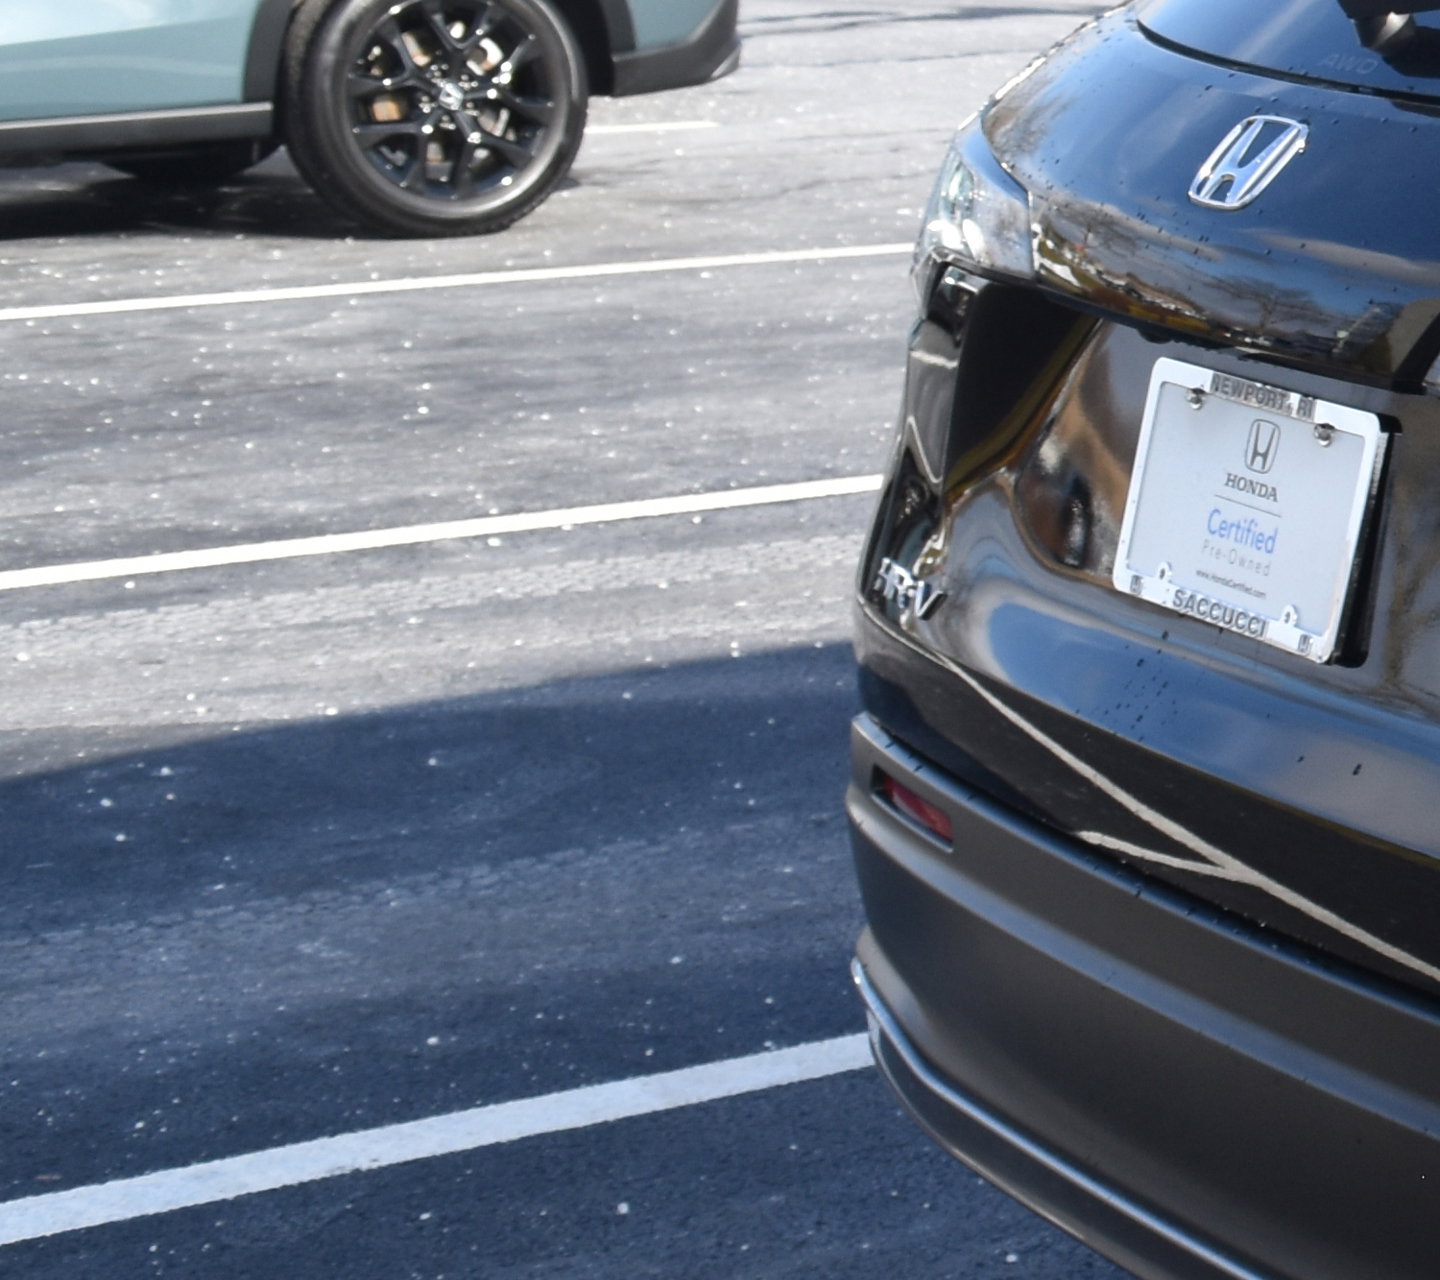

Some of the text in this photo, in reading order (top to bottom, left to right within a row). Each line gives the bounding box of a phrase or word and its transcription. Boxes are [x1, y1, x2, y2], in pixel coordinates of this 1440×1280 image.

[1318, 53, 1378, 74] AWD
[1296, 396, 1315, 419] RI
[1224, 472, 1278, 502] HONDA
[1207, 508, 1279, 554] Certified
[1172, 588, 1267, 638] SACCUCCI
